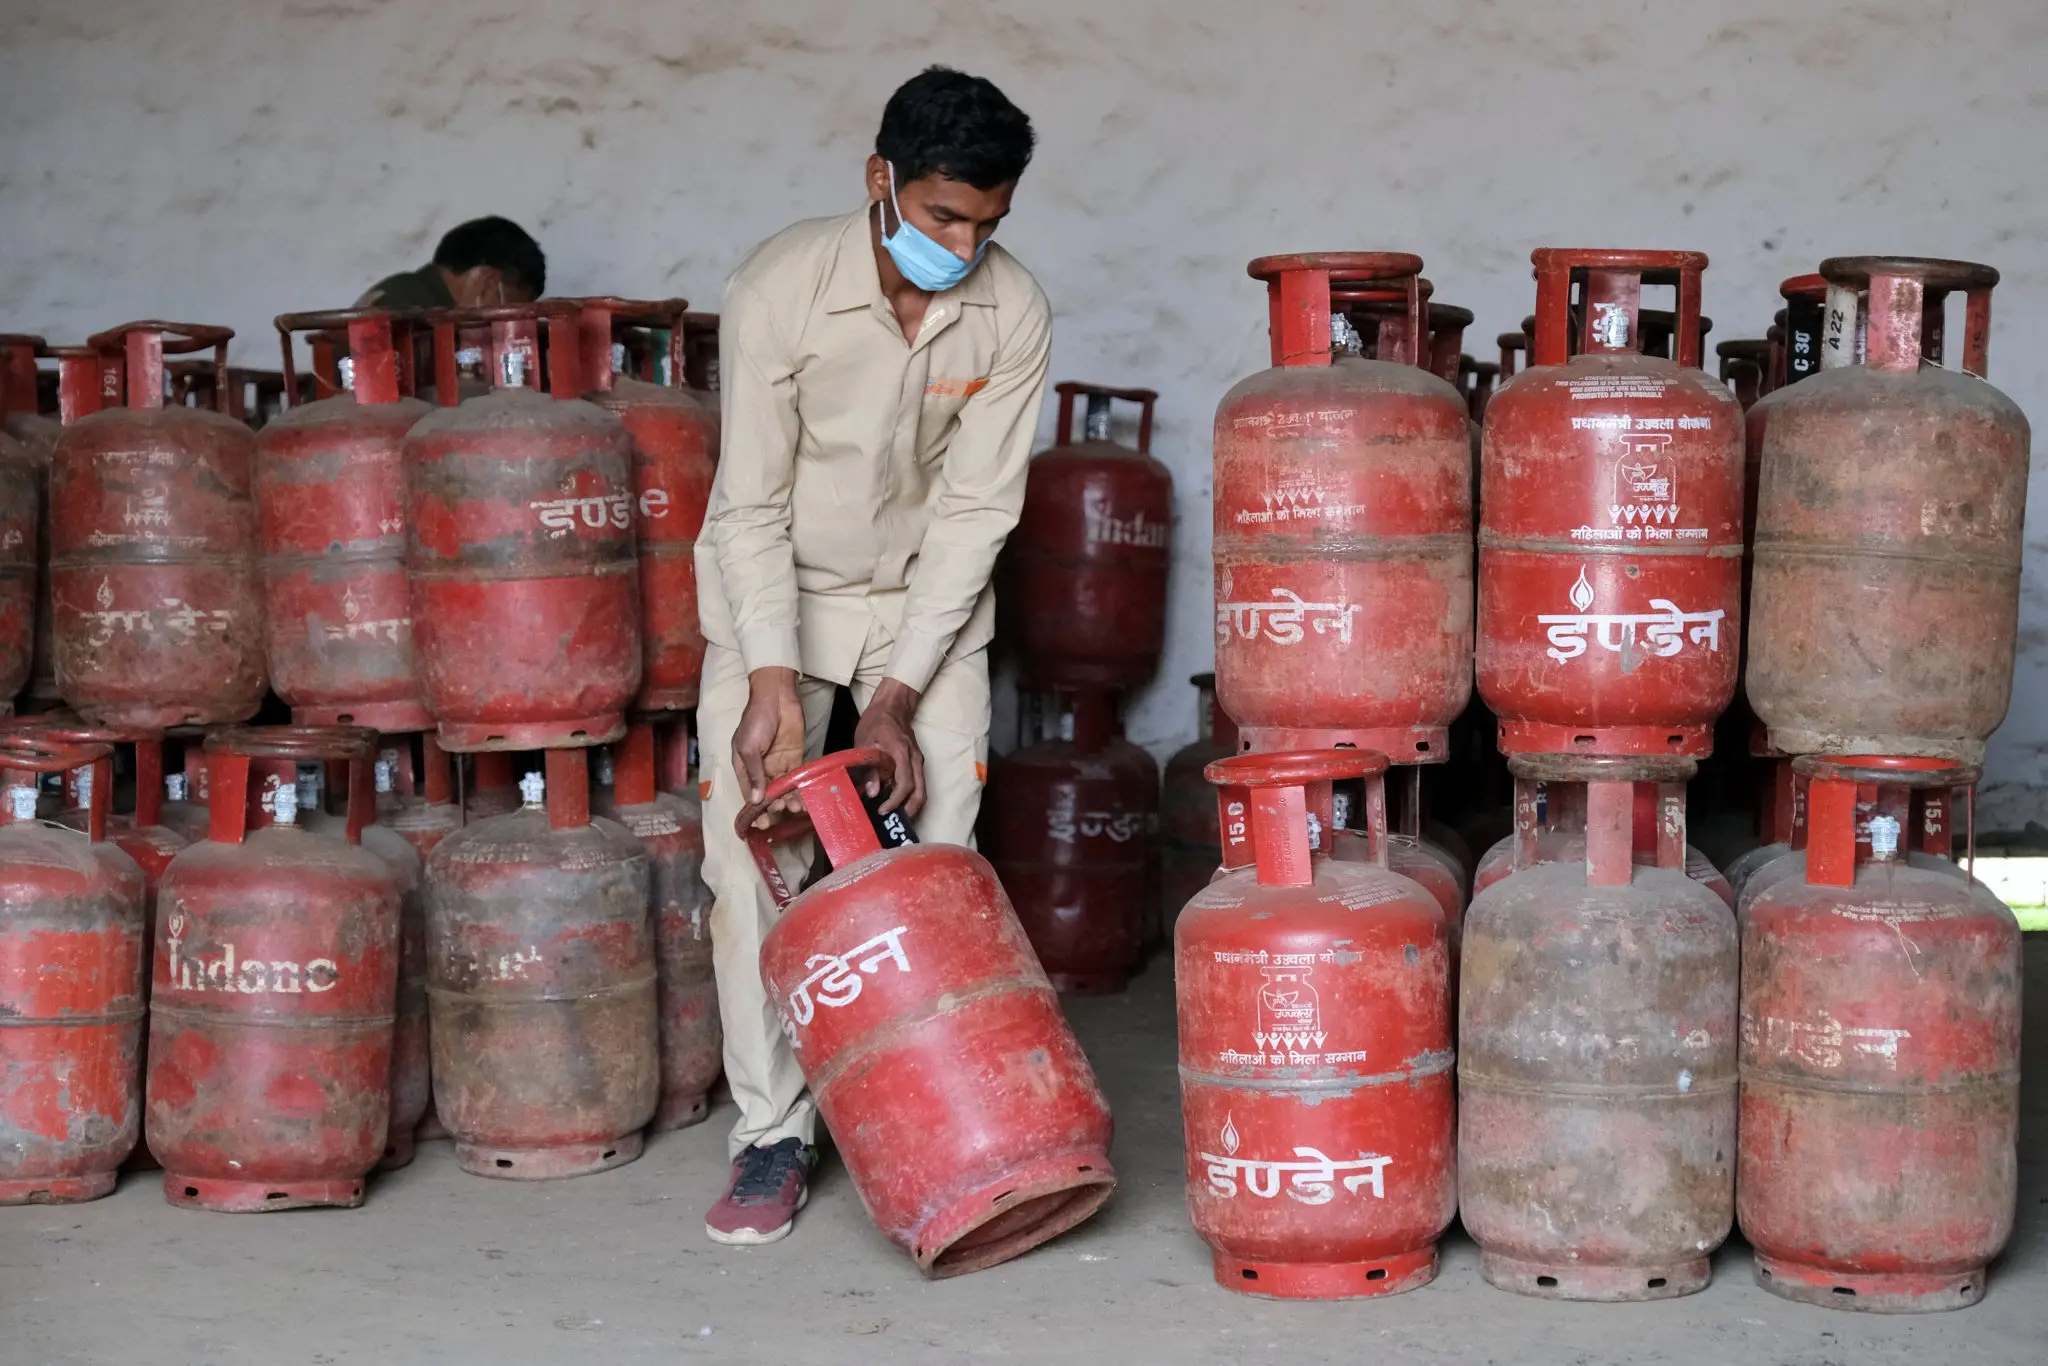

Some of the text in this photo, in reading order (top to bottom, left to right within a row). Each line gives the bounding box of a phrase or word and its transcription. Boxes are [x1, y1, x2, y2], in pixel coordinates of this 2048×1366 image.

[1829, 309, 1844, 350] A 22
[1794, 359, 1808, 371] C
[1626, 525, 1643, 540] को
[1645, 525, 1672, 540] मिला
[1270, 1051, 1285, 1065] को
[1289, 1051, 1320, 1066] मिला
